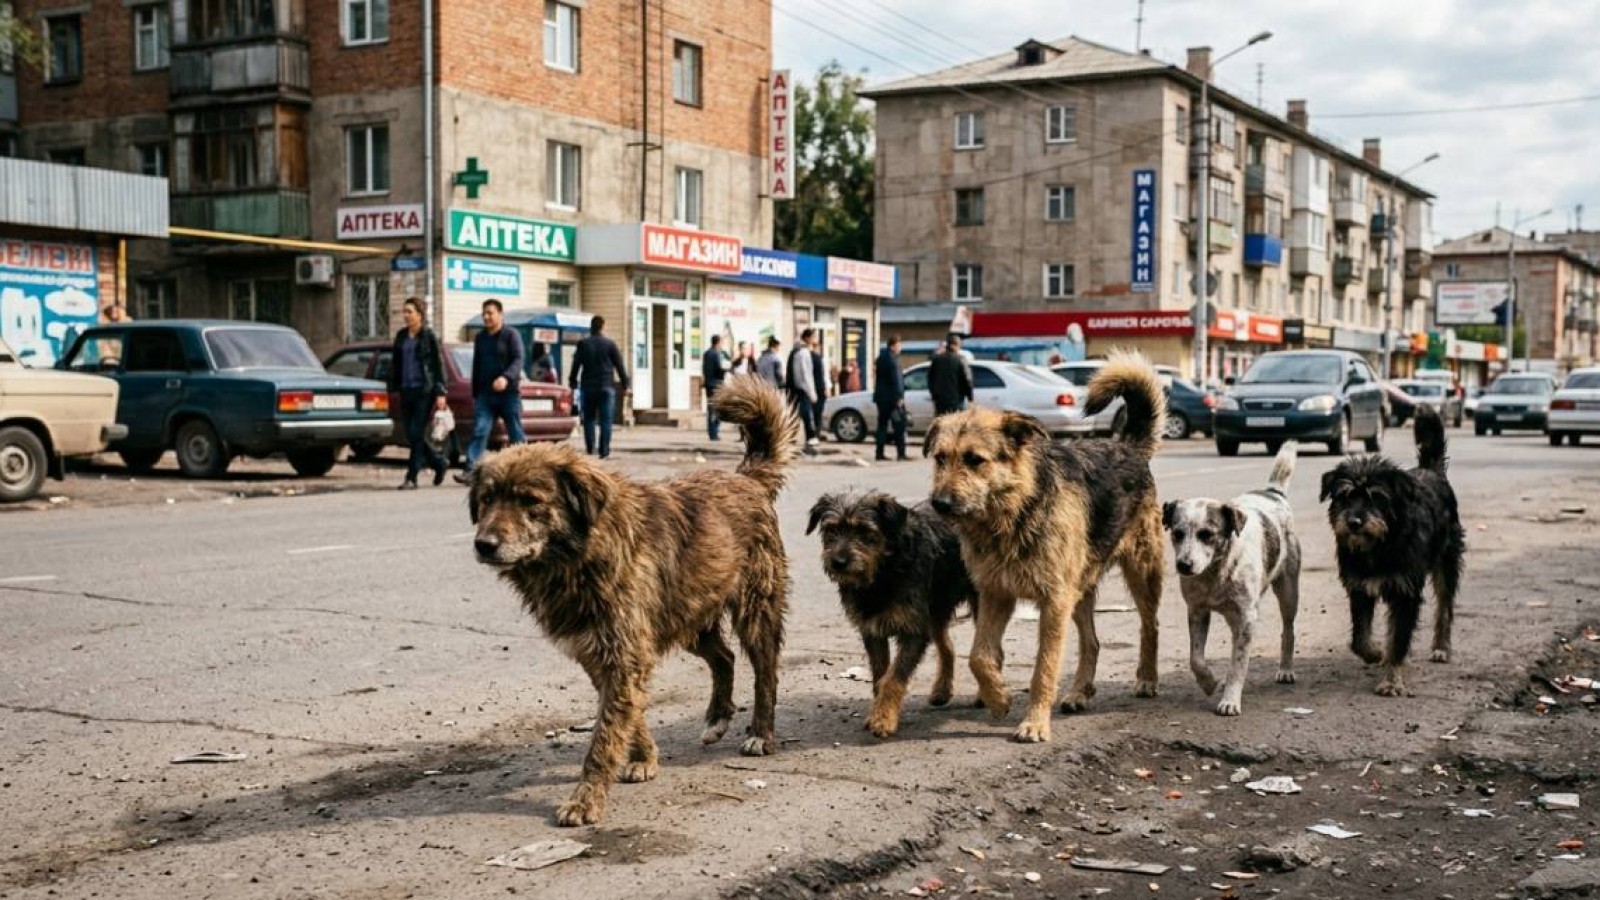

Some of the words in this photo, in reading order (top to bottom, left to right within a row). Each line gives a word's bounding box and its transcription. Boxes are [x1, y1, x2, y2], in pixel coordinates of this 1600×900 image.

[773, 74, 787, 194] АПТЕКА
[341, 211, 420, 233] АПТЕКА
[458, 216, 569, 256] АПТЕКА
[1136, 173, 1152, 281] МАГАЗИН
[648, 232, 738, 266] МАГАЗИН
